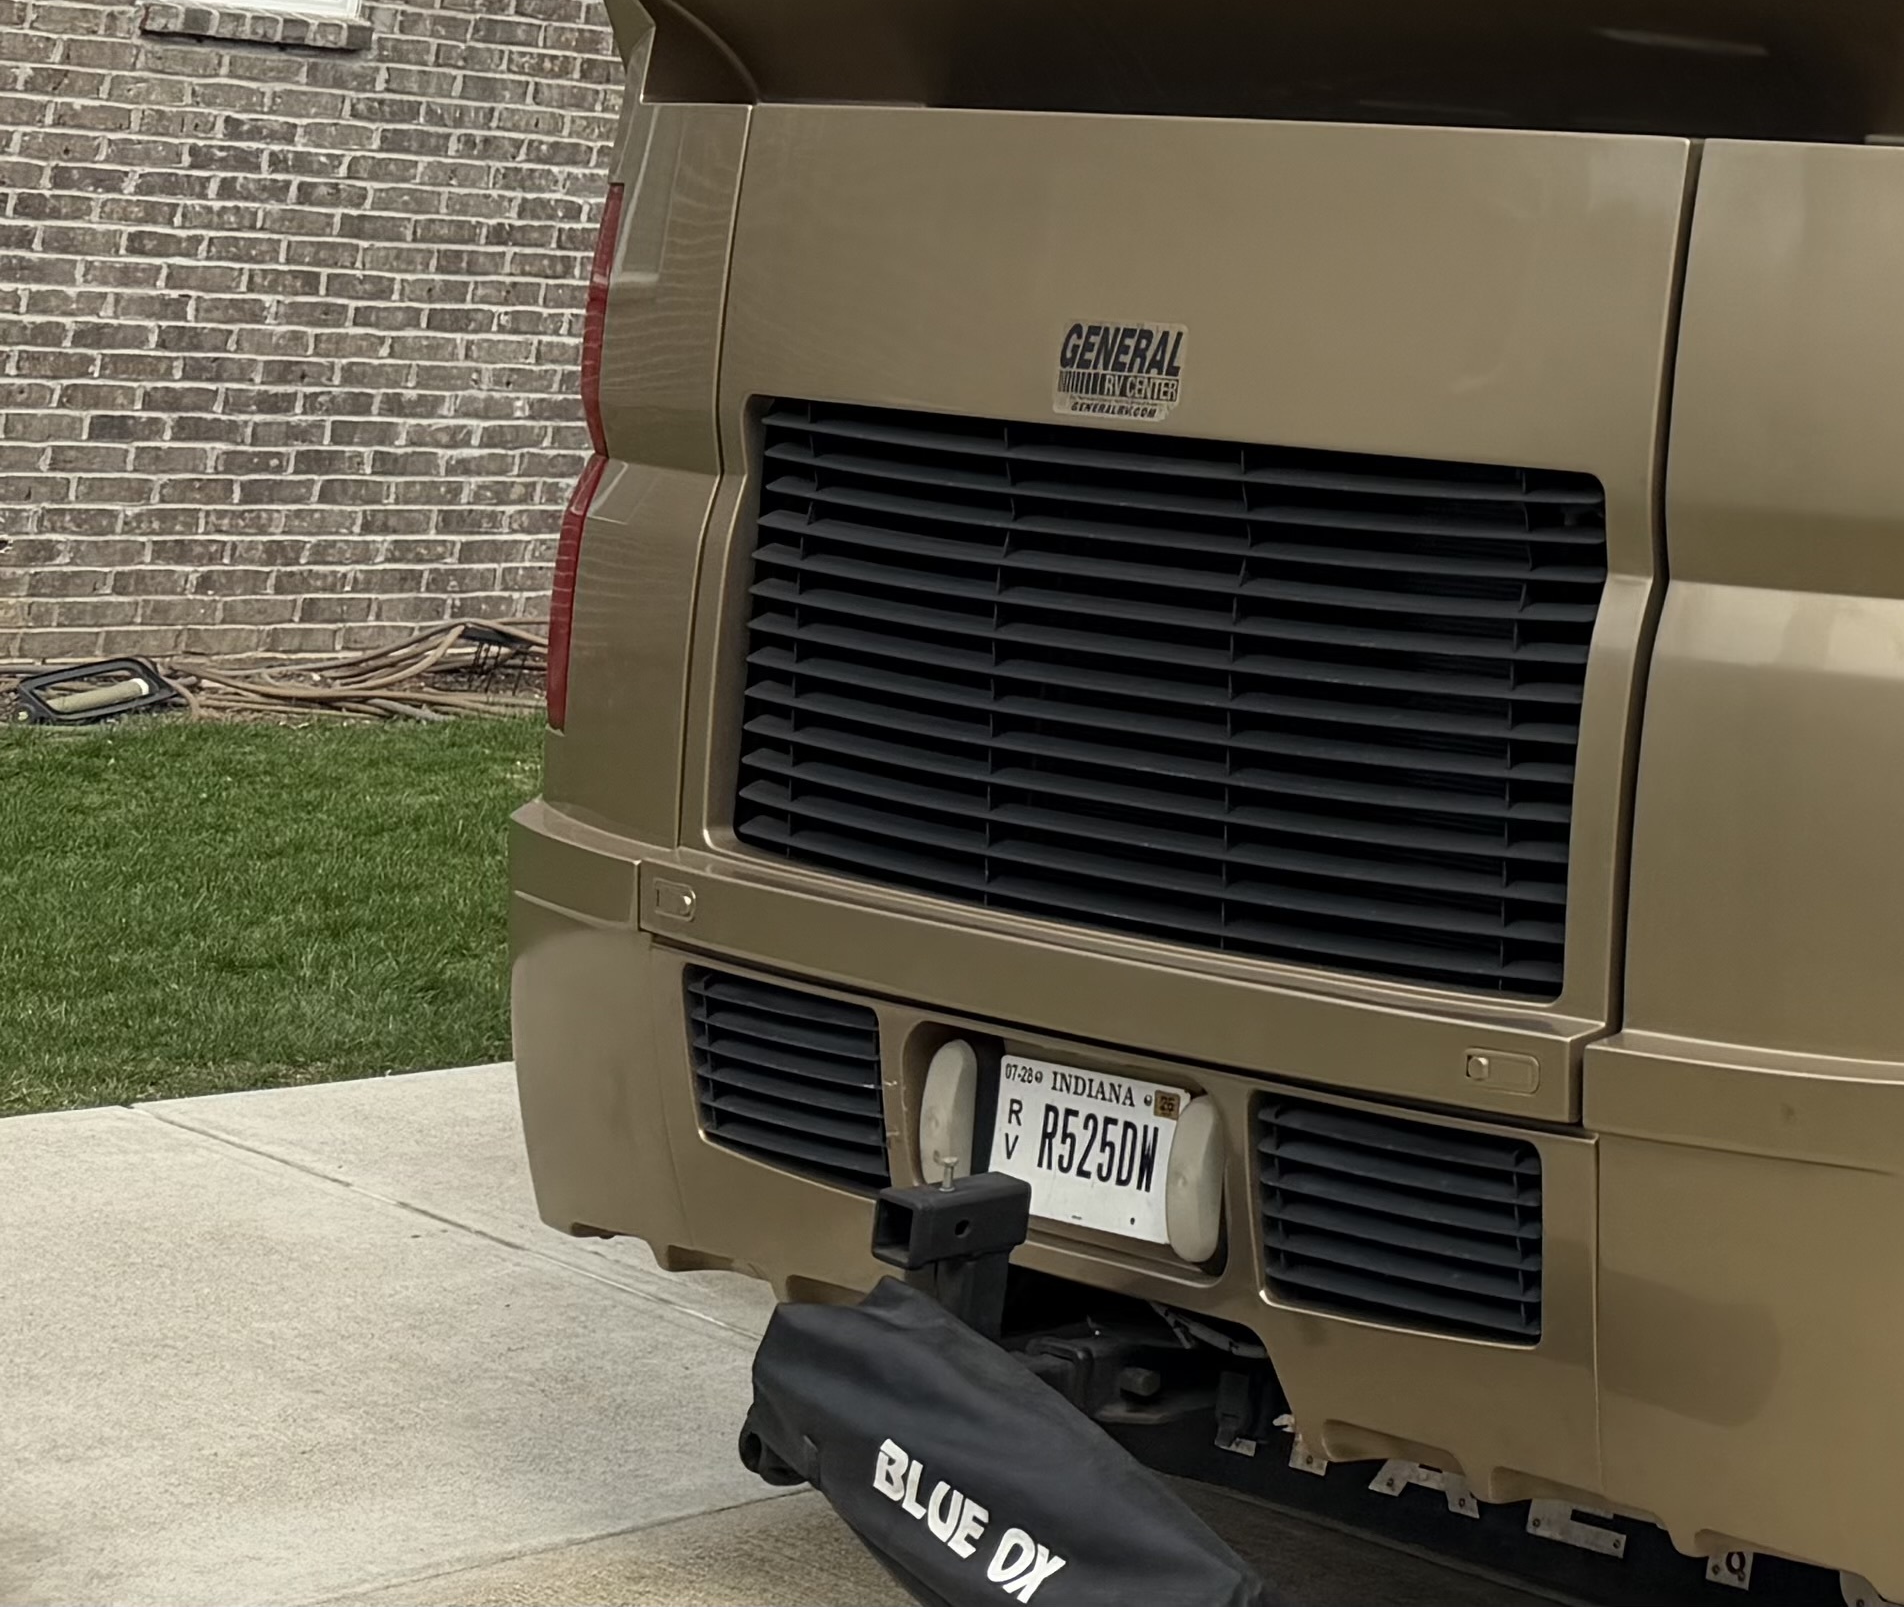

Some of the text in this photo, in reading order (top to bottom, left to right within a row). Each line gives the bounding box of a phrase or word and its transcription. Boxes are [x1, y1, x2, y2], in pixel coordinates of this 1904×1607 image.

[1060, 323, 1184, 377] GENERAL
[1103, 374, 1124, 398] RV
[1126, 377, 1178, 402] CENTER
[1004, 1062, 1034, 1085] 07-28
[1050, 1070, 1136, 1108] INDIANA
[1037, 1102, 1159, 1194] R525DW
[872, 1437, 1067, 1604] BLUE OX
